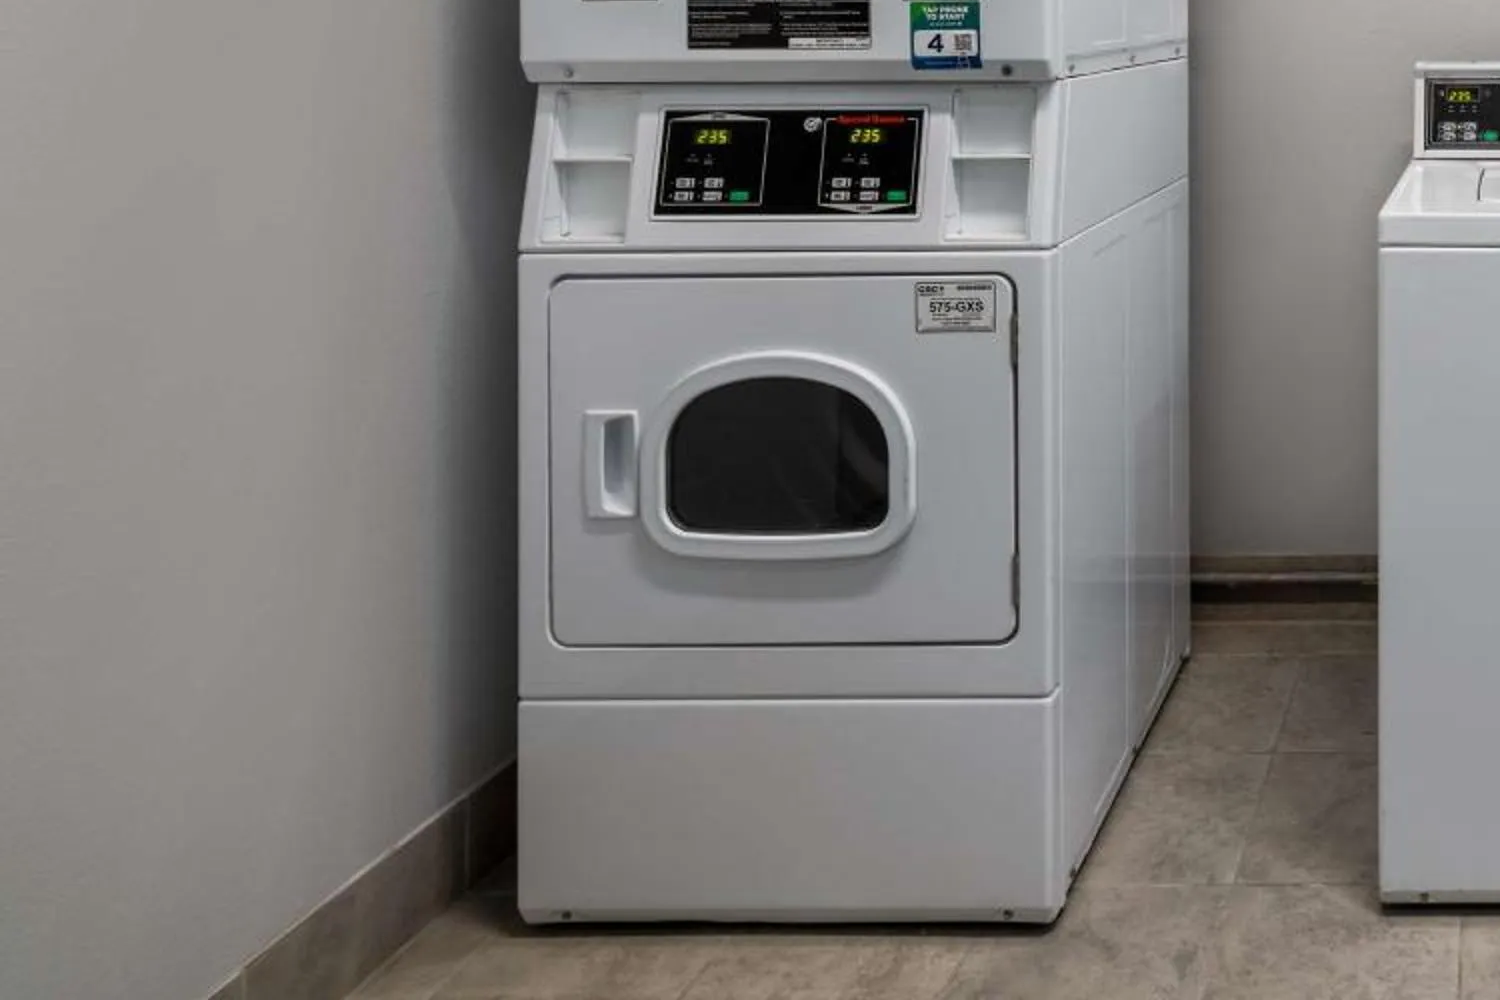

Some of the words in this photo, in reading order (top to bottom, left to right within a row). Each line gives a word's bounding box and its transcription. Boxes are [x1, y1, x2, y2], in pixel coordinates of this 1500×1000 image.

[928, 34, 944, 53] 4
[698, 129, 727, 145] 235
[851, 128, 881, 143] 235
[929, 300, 984, 313] 575-GXS
